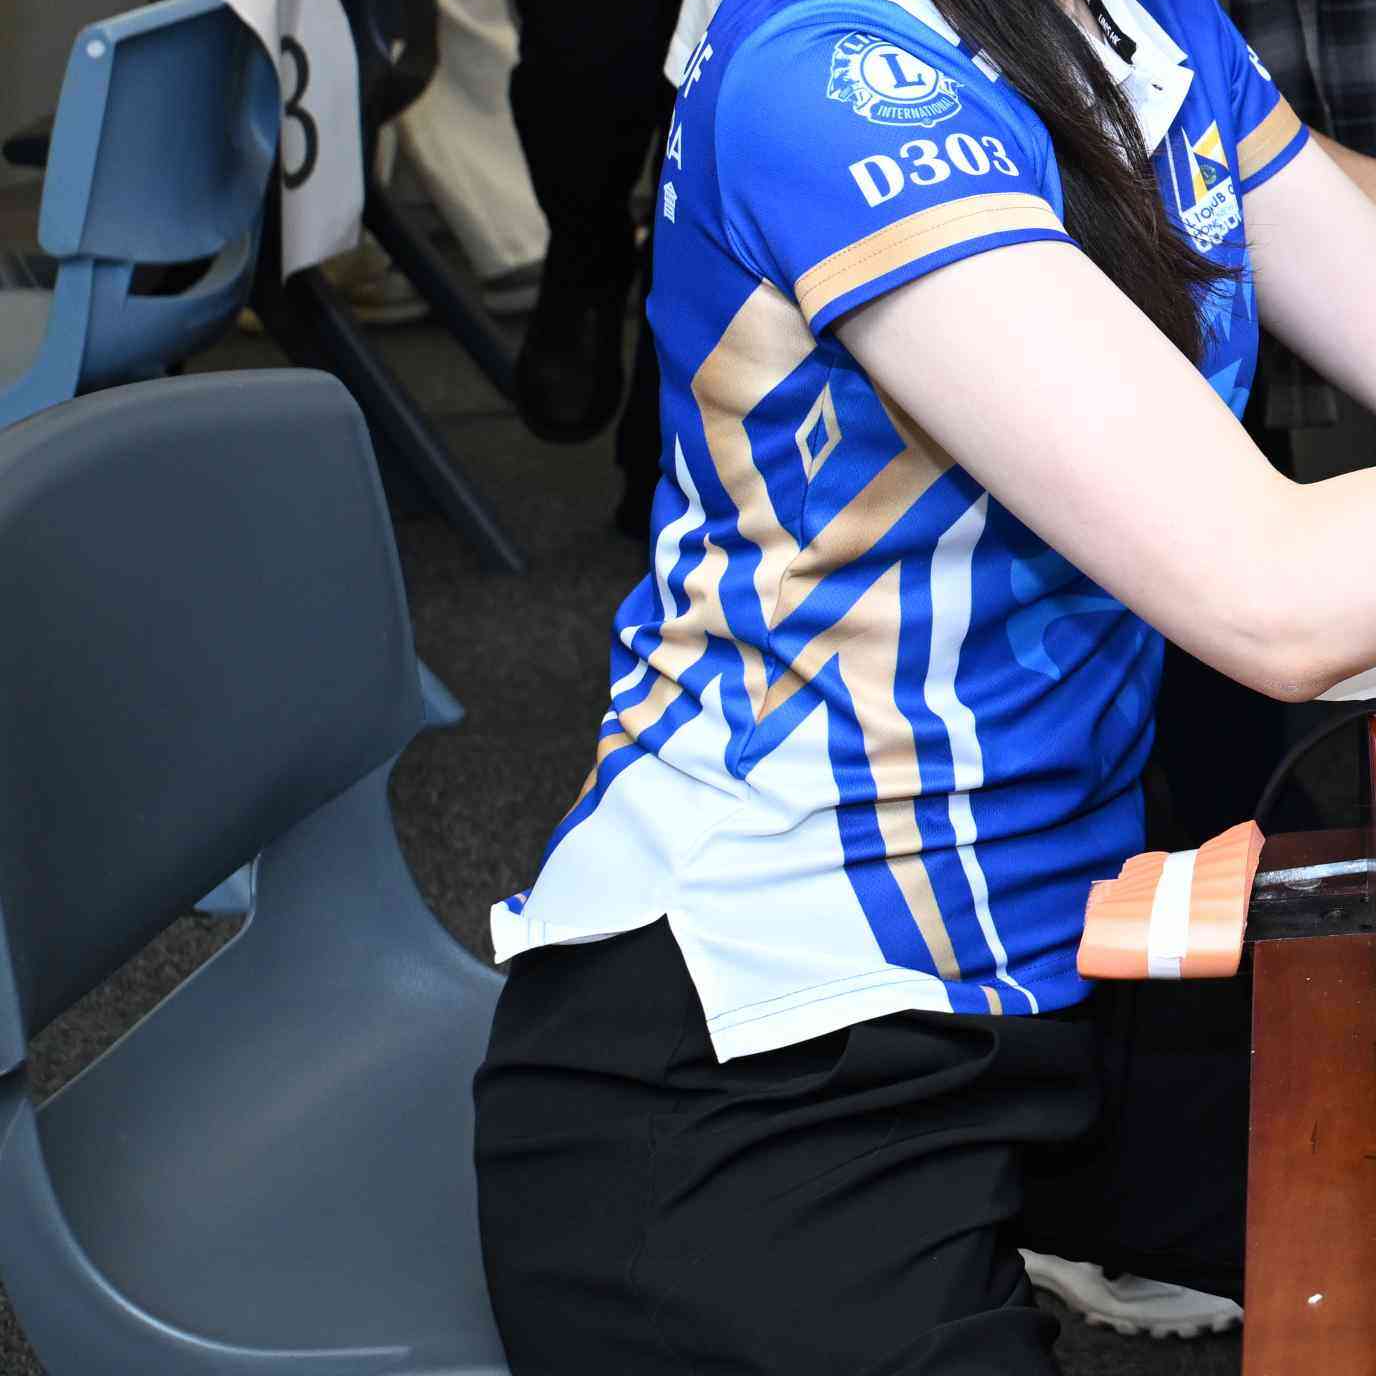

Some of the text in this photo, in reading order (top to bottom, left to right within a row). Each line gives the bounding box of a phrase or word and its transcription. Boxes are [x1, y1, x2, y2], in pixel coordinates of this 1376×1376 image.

[879, 53, 927, 88] L
[877, 95, 955, 119] INTERNATIONAL
[848, 133, 1019, 207] D303
